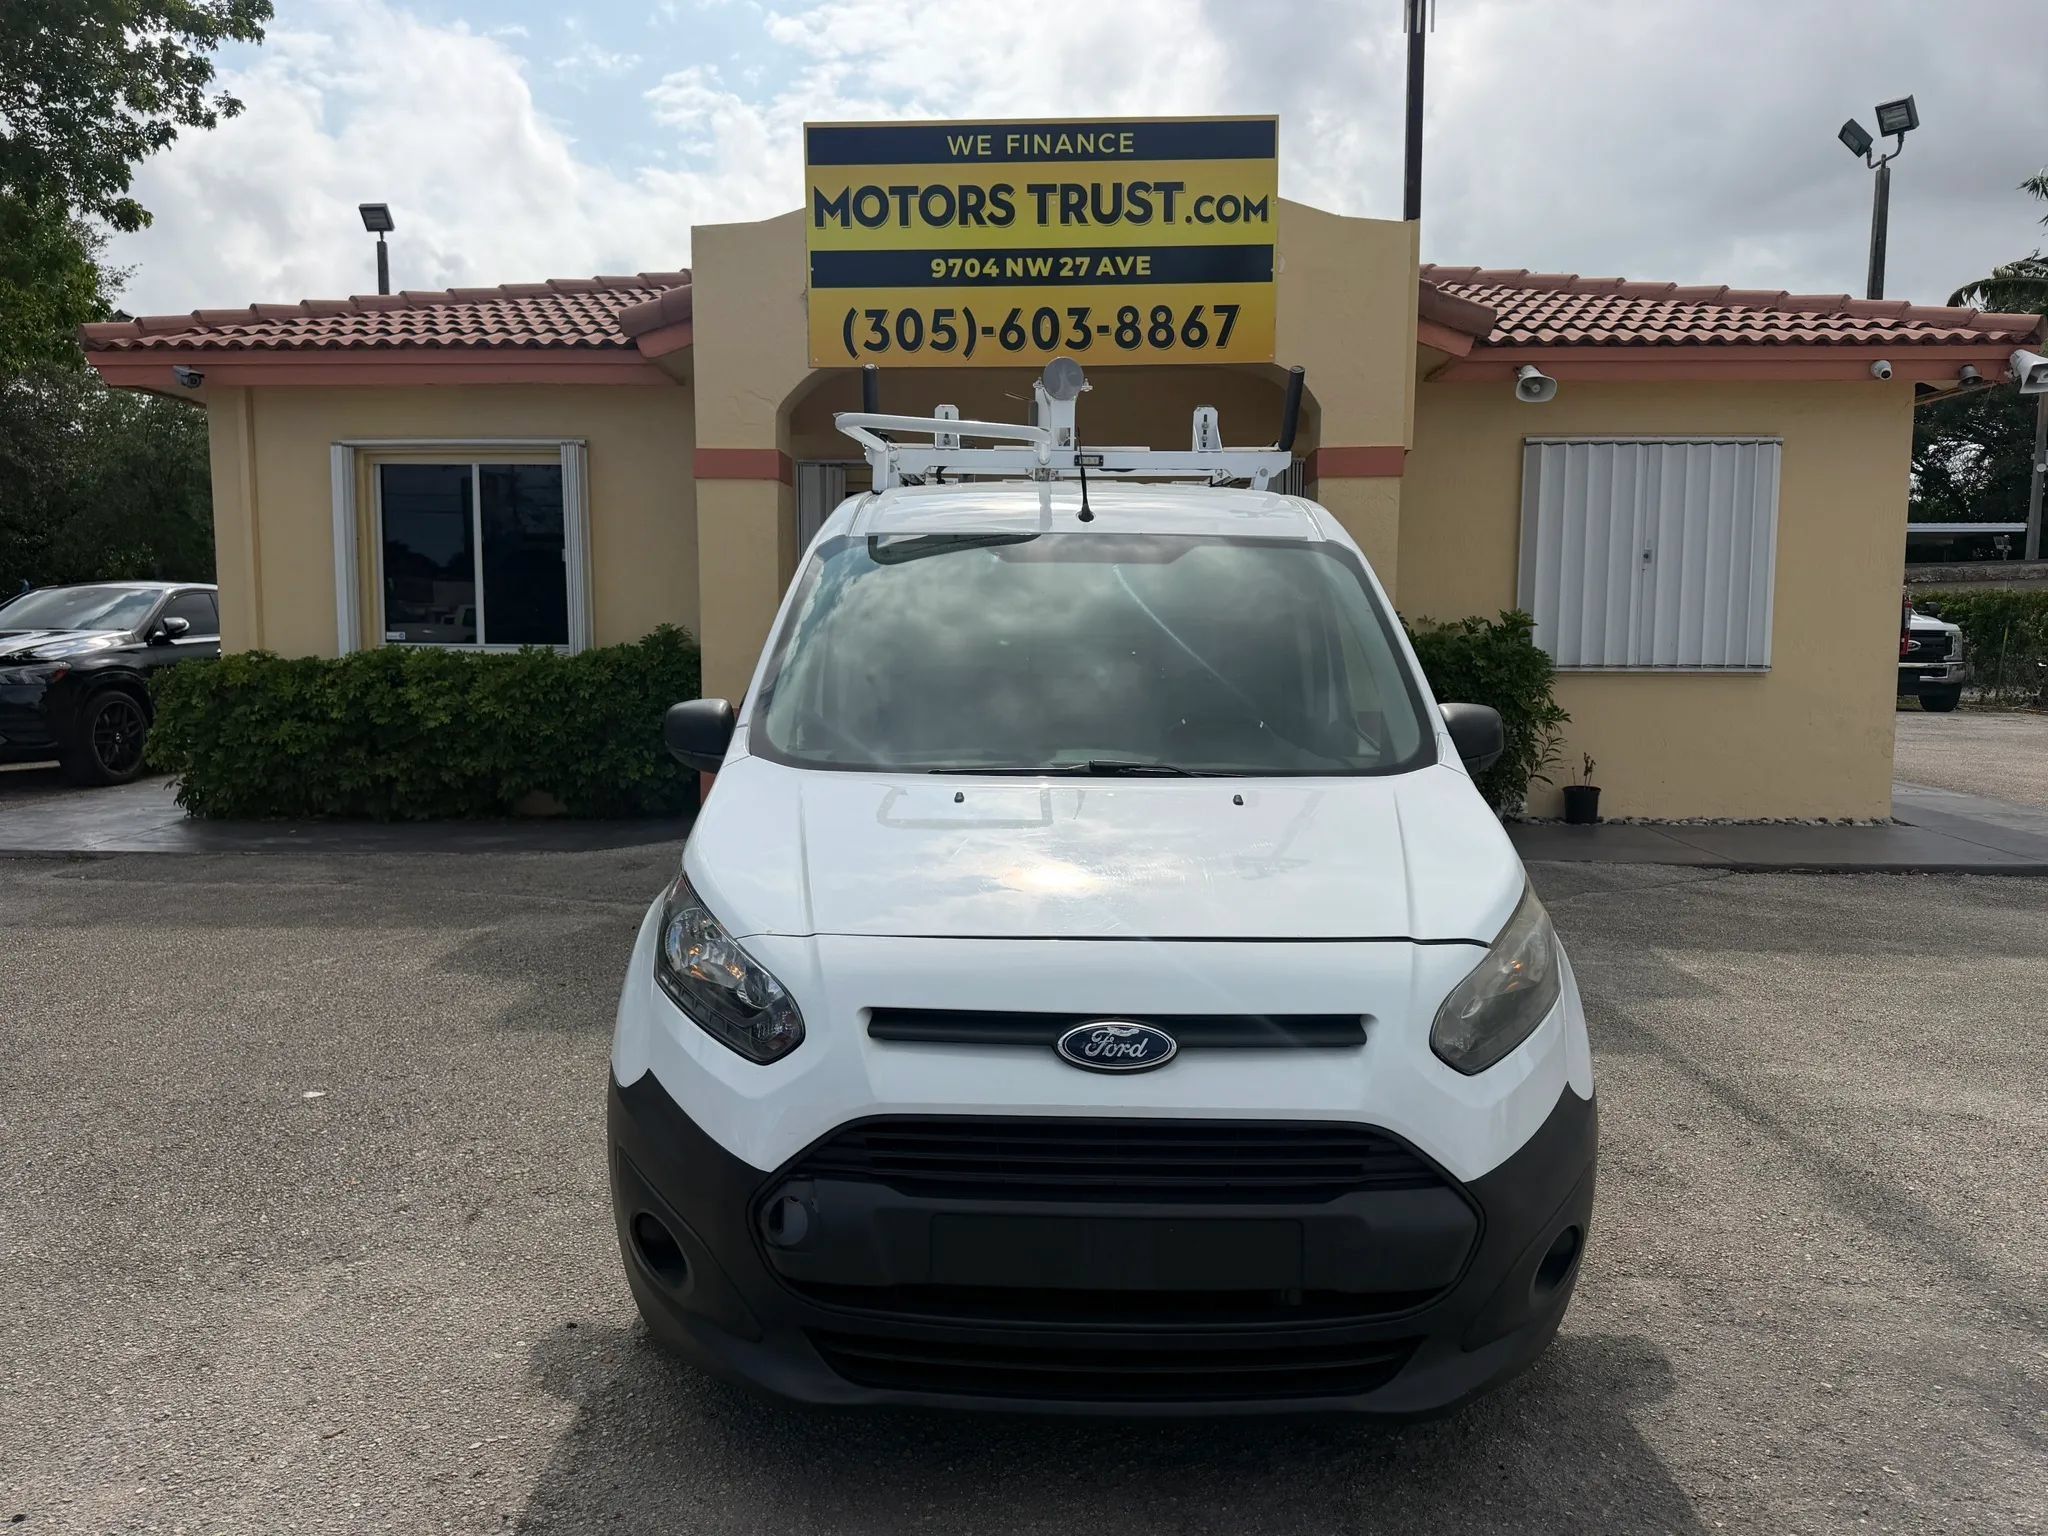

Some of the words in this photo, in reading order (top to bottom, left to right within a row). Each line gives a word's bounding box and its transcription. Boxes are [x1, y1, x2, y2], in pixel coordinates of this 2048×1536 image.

[947, 134, 992, 156] WE
[1007, 132, 1135, 155] FINANCE
[813, 183, 1016, 229] MOTORS
[930, 257, 1000, 278] 9704
[1005, 257, 1053, 277] NW
[1059, 257, 1091, 277] 27
[1096, 255, 1151, 276] AVE
[843, 304, 1241, 360] (305)-603-8867
[1084, 1026, 1149, 1057] Ford
